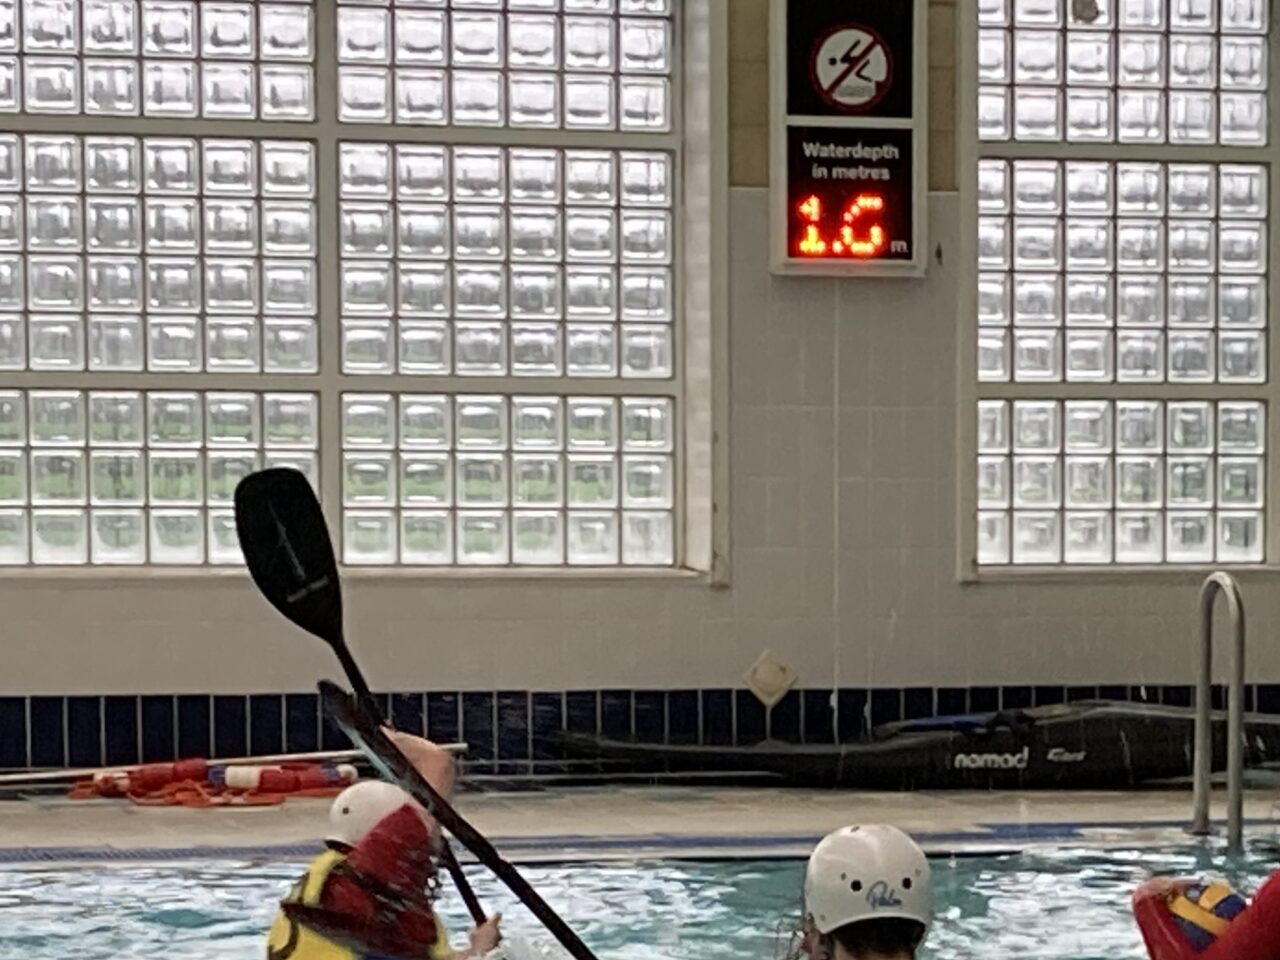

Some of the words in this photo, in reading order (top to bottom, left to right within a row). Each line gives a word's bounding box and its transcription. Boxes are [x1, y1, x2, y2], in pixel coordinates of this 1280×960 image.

[802, 141, 899, 161] Waterdepth
[812, 164, 828, 178] in
[832, 165, 890, 180] metres
[799, 194, 884, 254] 1.6
[891, 240, 908, 252] m
[954, 745, 1030, 769] nomad
